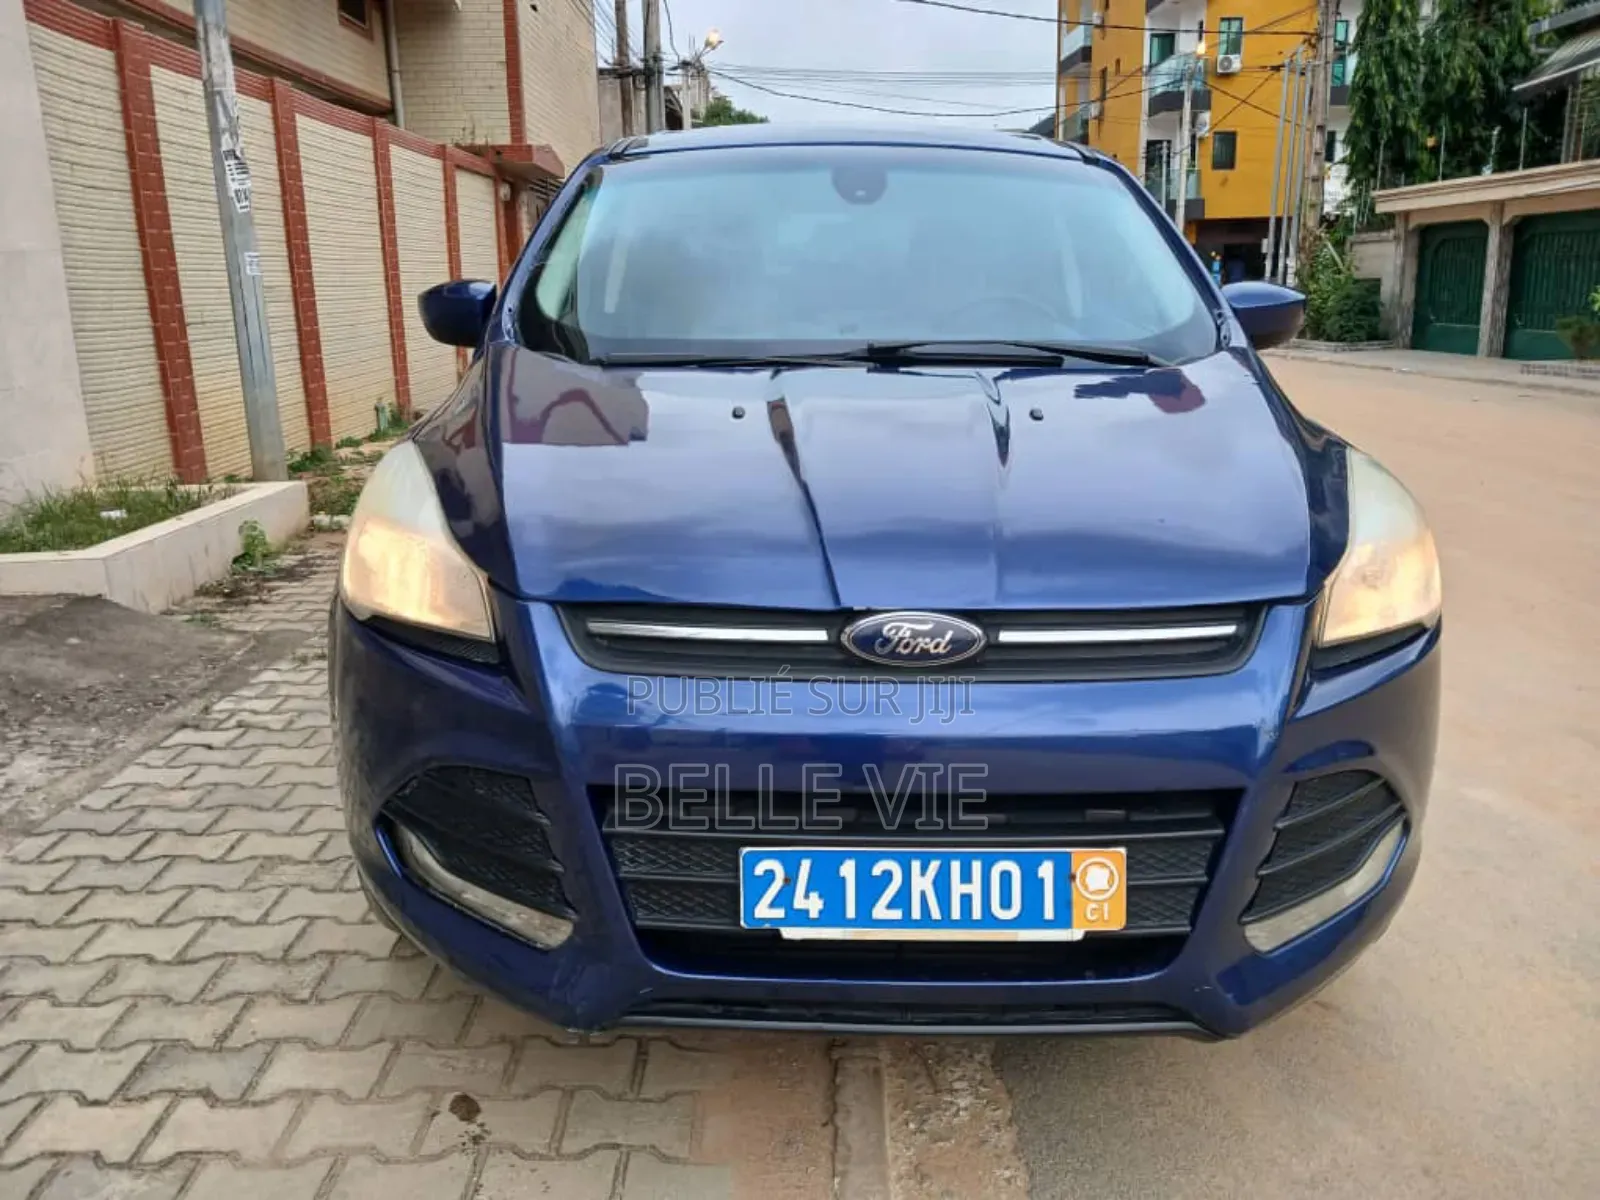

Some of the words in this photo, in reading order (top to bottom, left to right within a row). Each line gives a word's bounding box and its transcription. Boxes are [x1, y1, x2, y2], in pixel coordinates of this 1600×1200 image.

[874, 621, 953, 655] Ford
[753, 858, 1055, 920] 2412KH01
[1085, 904, 1109, 921] CI
